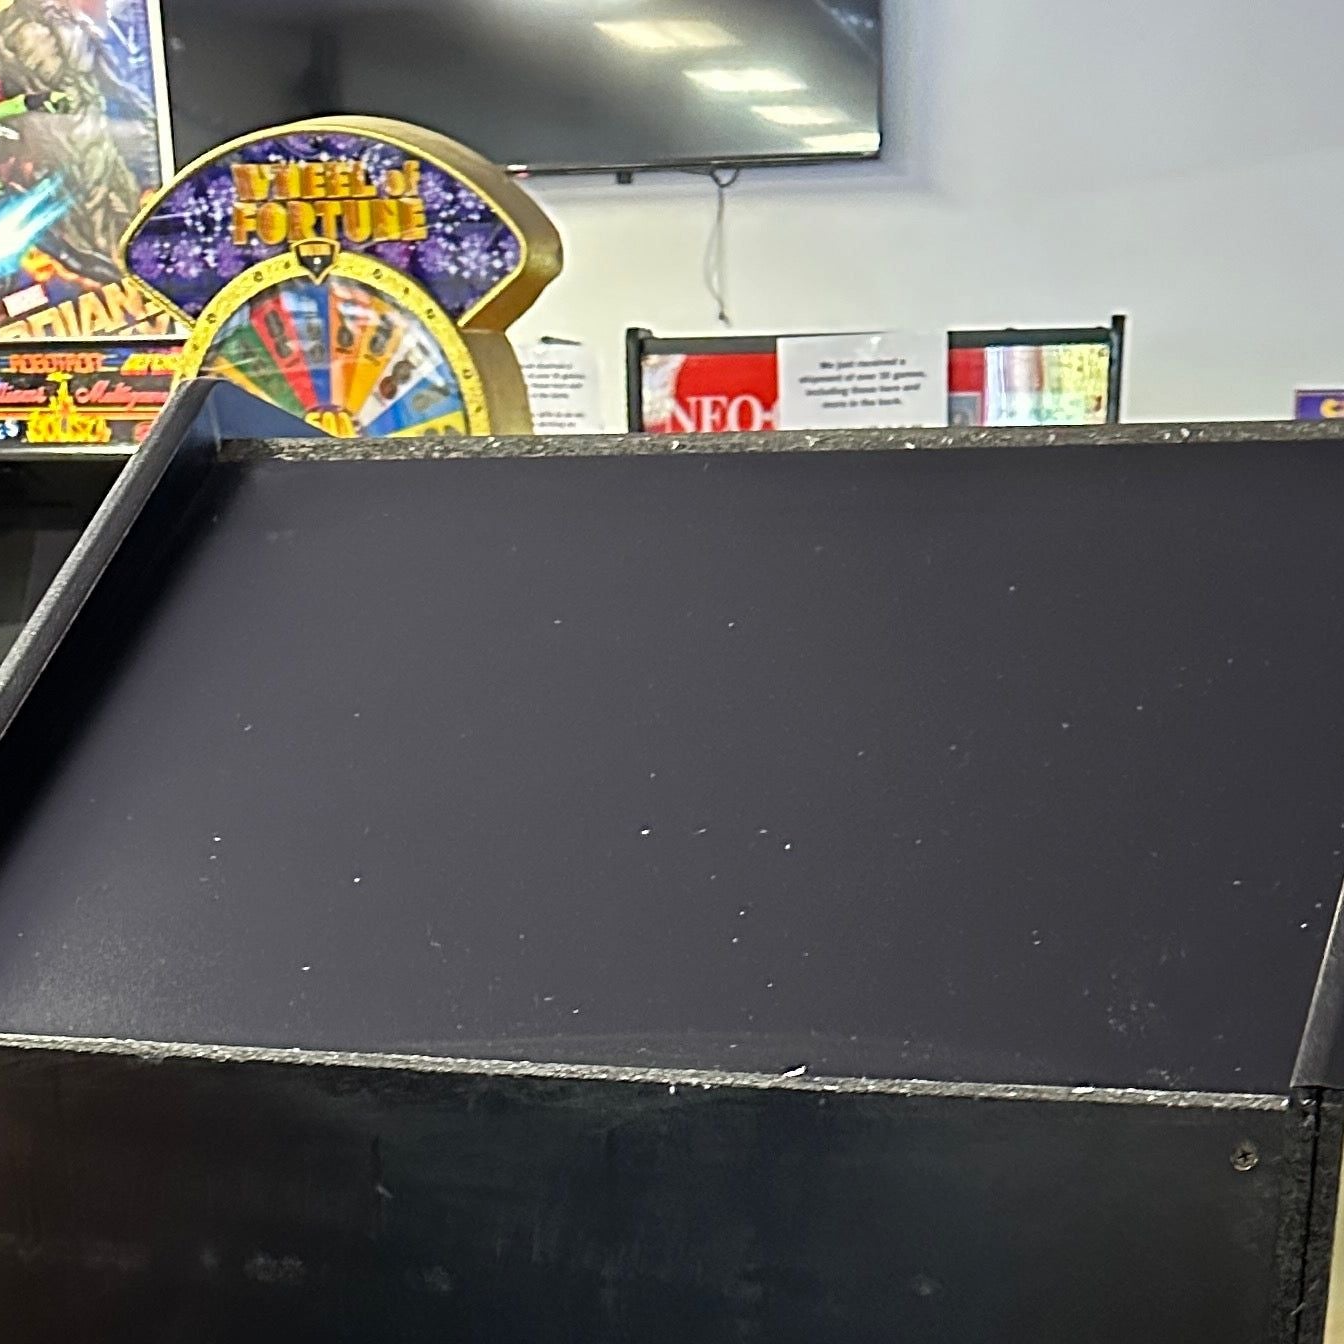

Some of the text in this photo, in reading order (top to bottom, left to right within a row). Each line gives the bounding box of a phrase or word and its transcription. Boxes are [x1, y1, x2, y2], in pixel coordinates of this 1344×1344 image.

[230, 160, 421, 200] WHEEL of
[231, 197, 428, 246] FORTUNE
